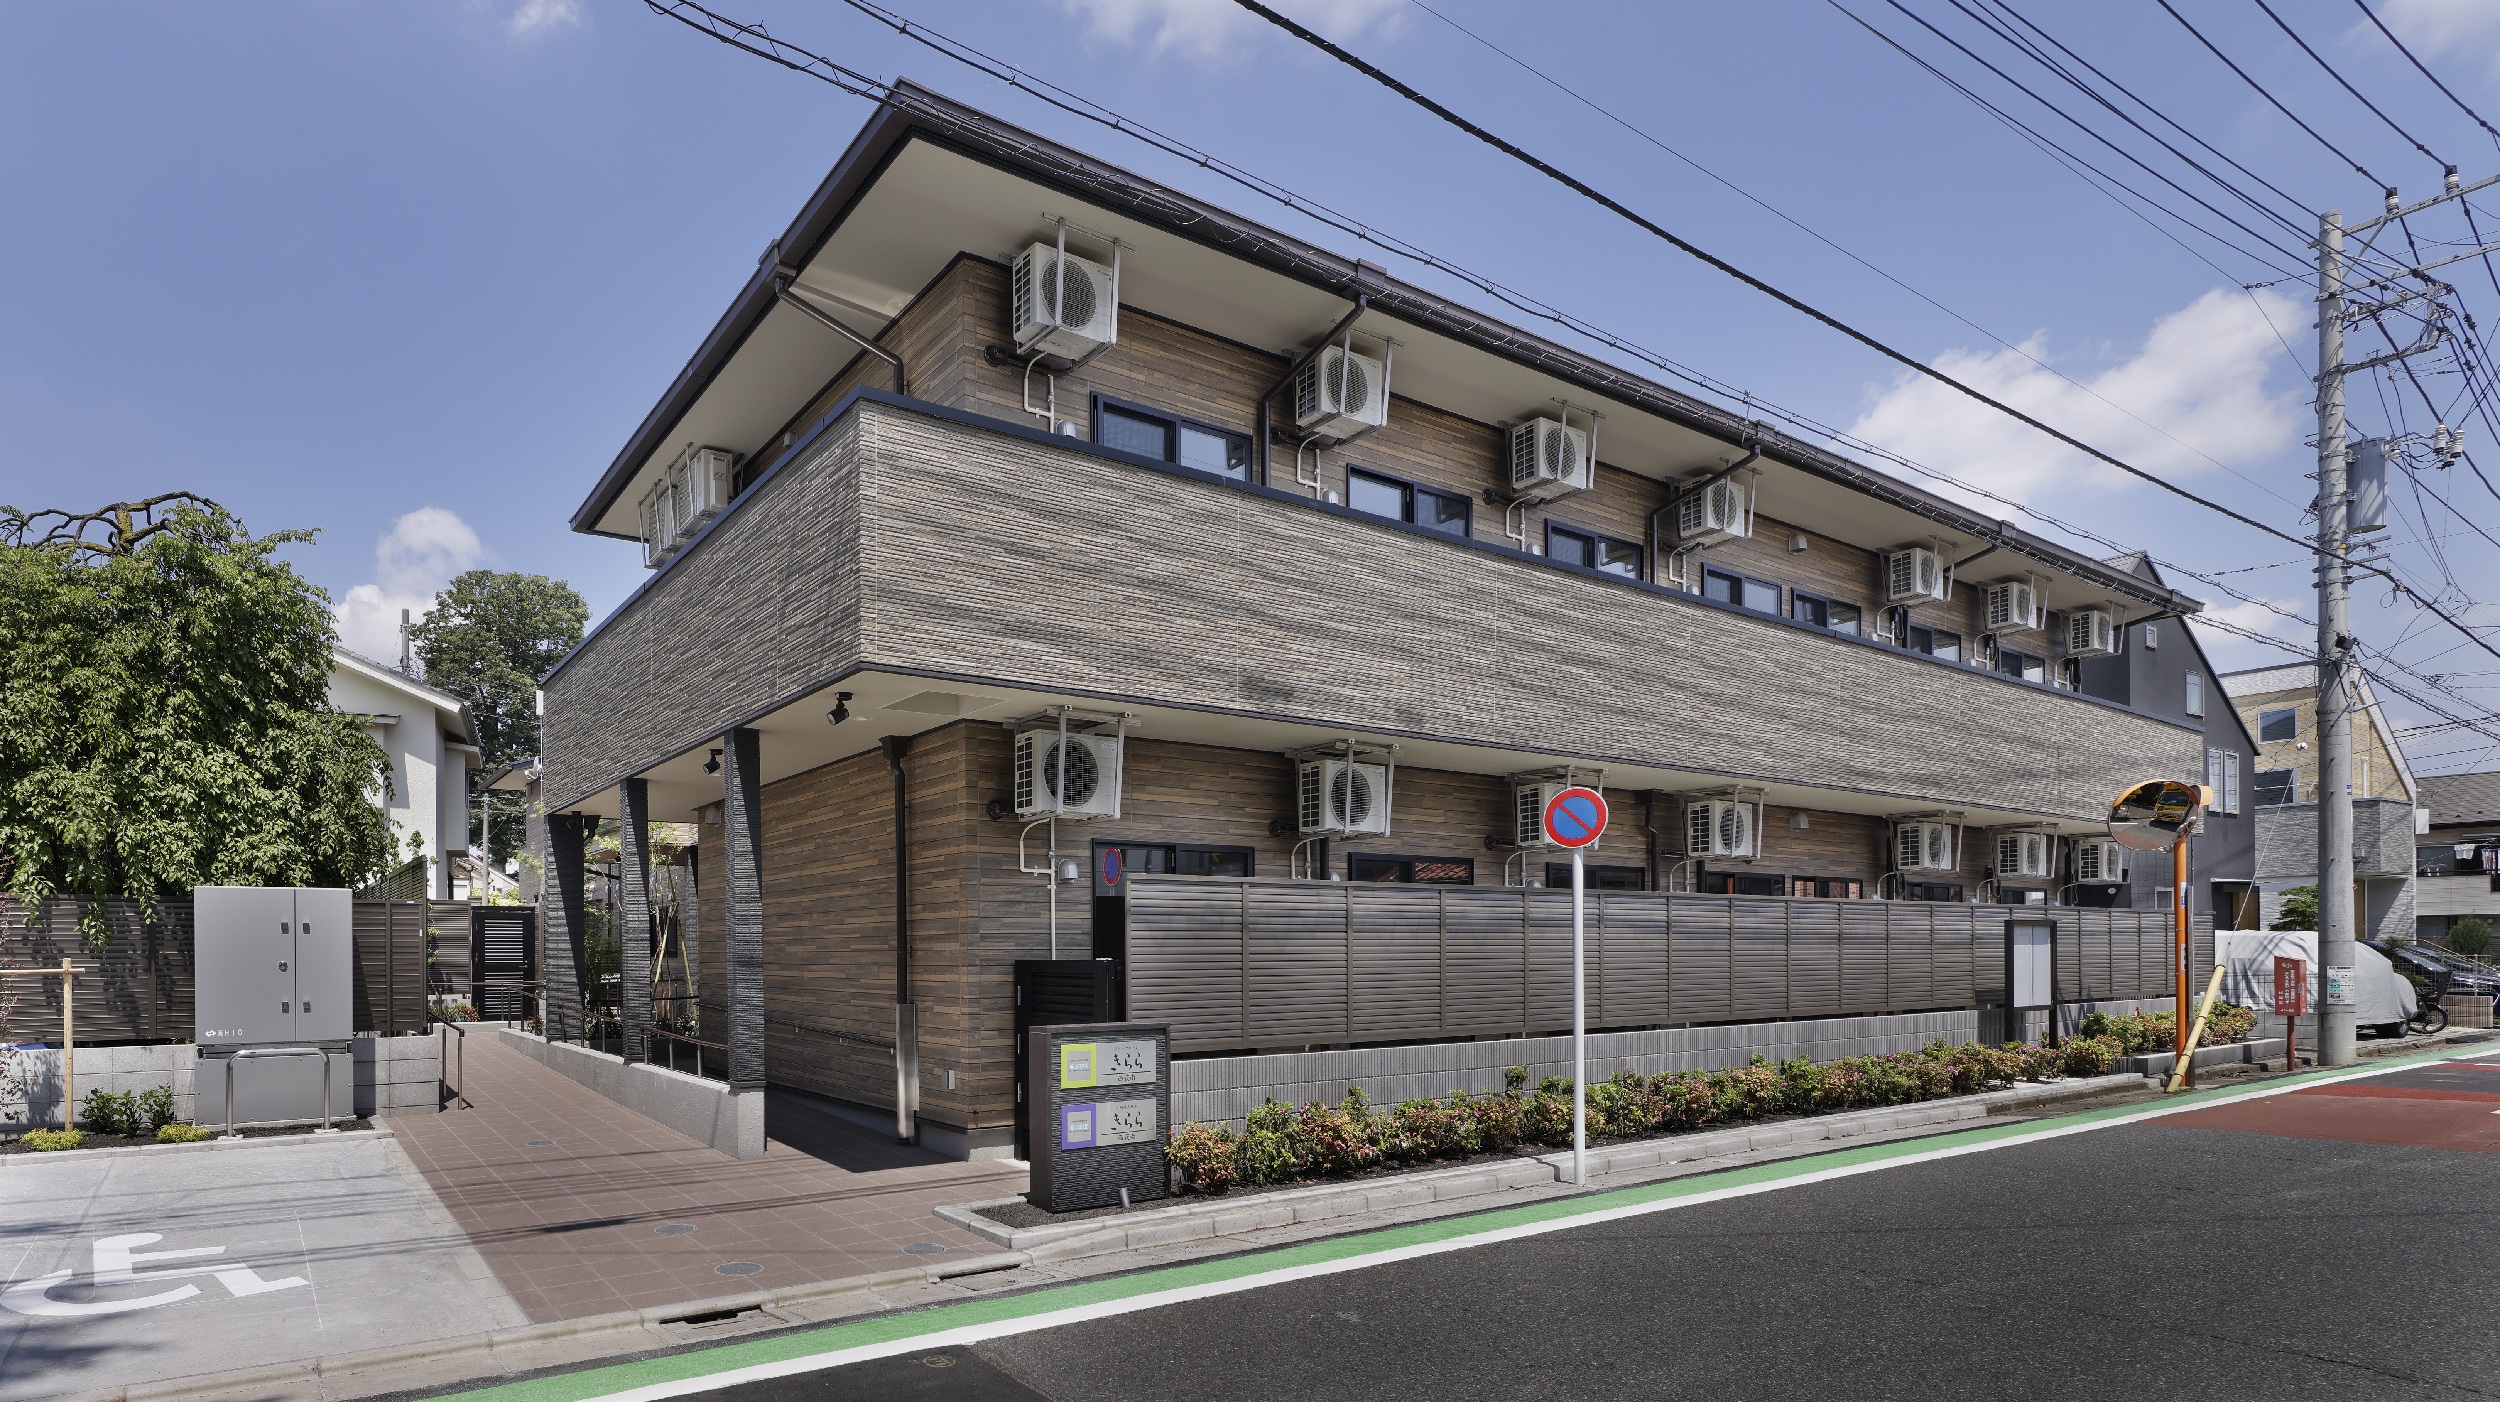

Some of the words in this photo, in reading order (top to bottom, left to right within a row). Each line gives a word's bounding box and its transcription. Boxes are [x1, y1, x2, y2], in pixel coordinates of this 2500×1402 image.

[1111, 1053, 1142, 1071] きらら
[1111, 1111, 1142, 1130] きらら
